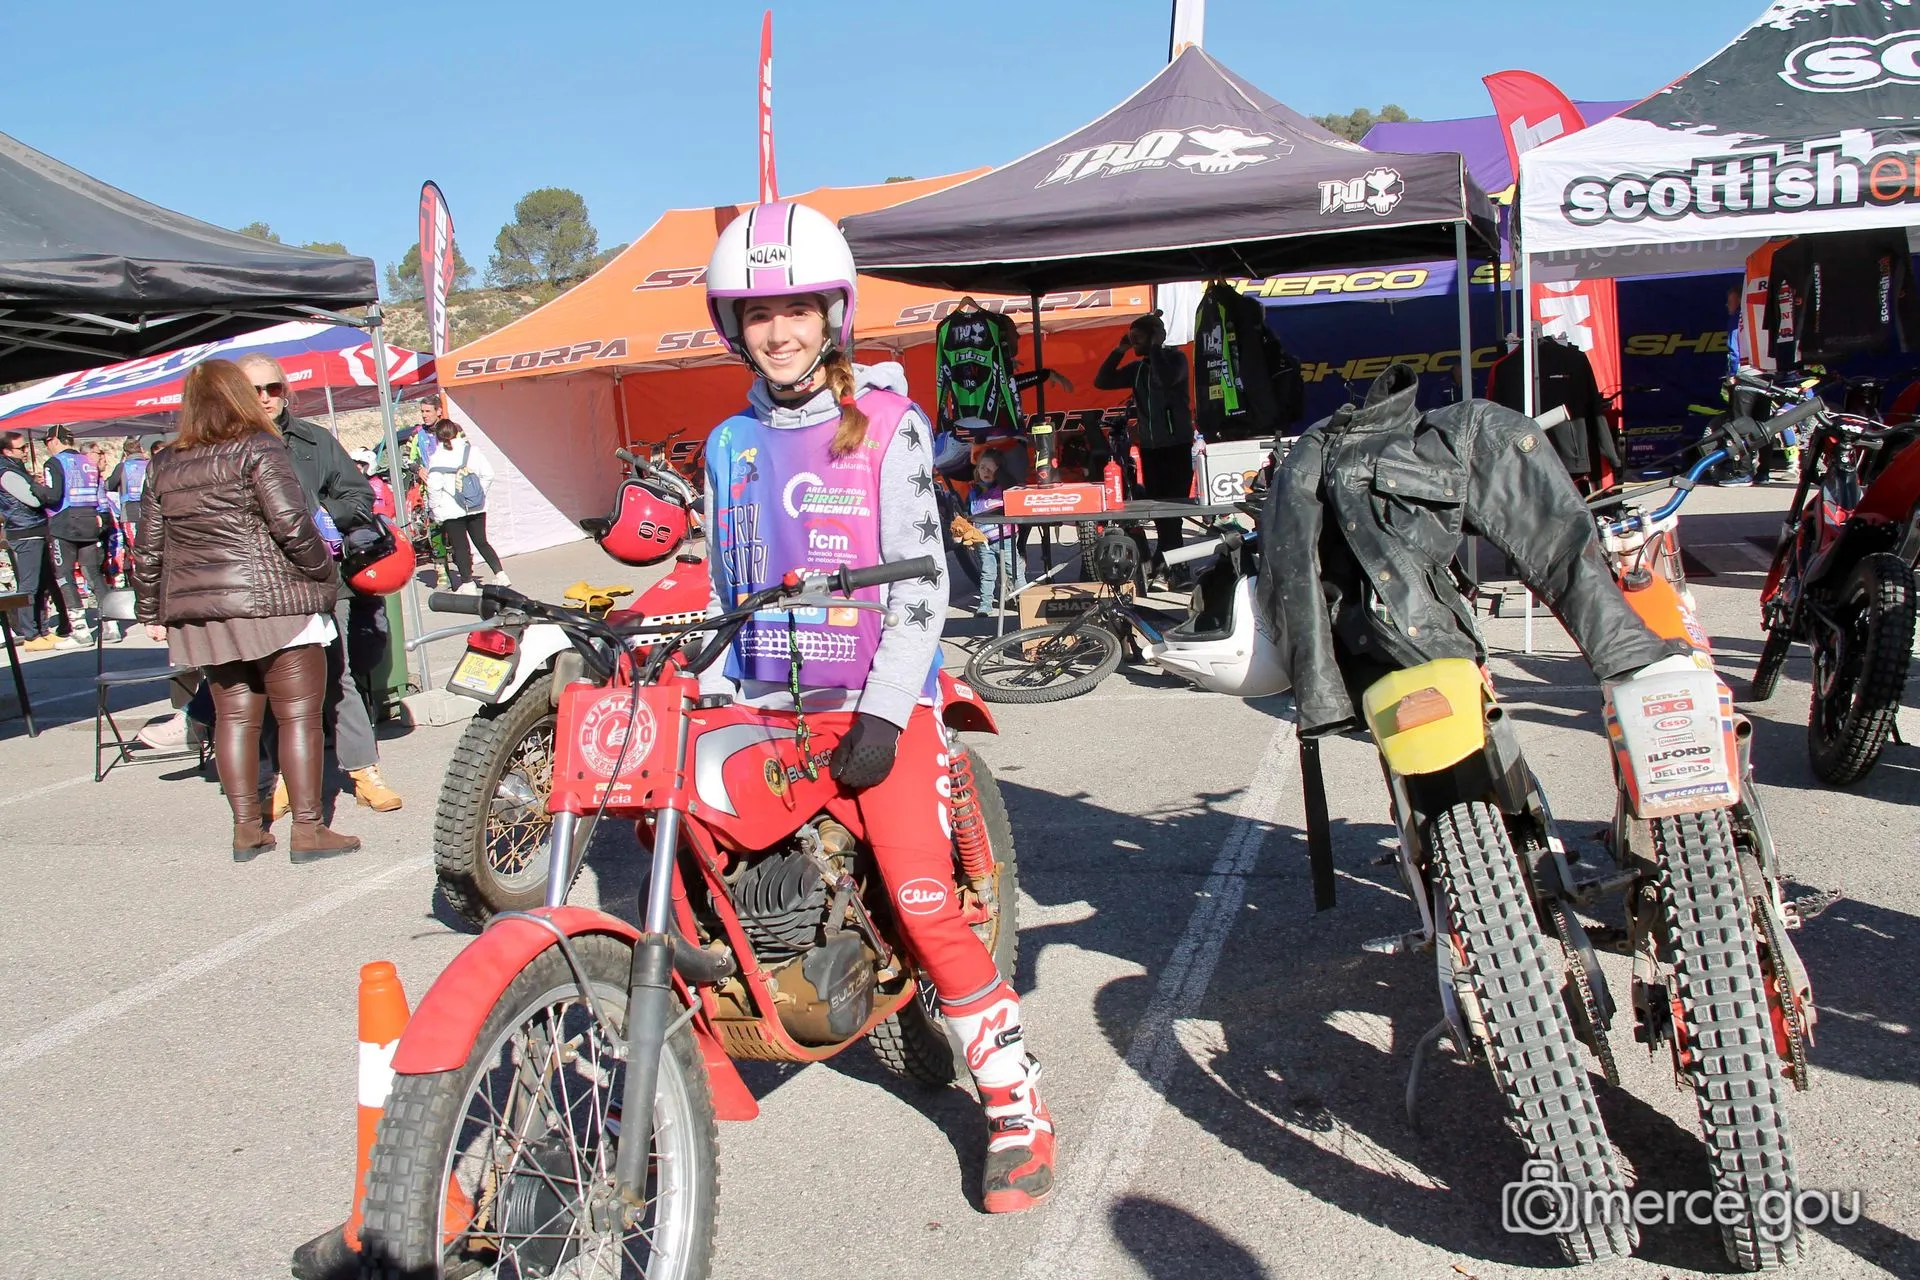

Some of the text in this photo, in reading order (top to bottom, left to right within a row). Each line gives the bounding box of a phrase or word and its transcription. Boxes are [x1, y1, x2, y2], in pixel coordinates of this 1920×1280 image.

[1569, 152, 1920, 220] scottishe
[750, 247, 787, 264] NOLAN
[454, 338, 628, 377] SCORPA
[806, 486, 828, 494] AREA
[803, 493, 864, 505] CIRCUIT
[808, 528, 849, 551] fcm
[1647, 746, 1711, 763] ILFORD
[1664, 784, 1724, 798] MICHELIN
[901, 889, 945, 904] Clice
